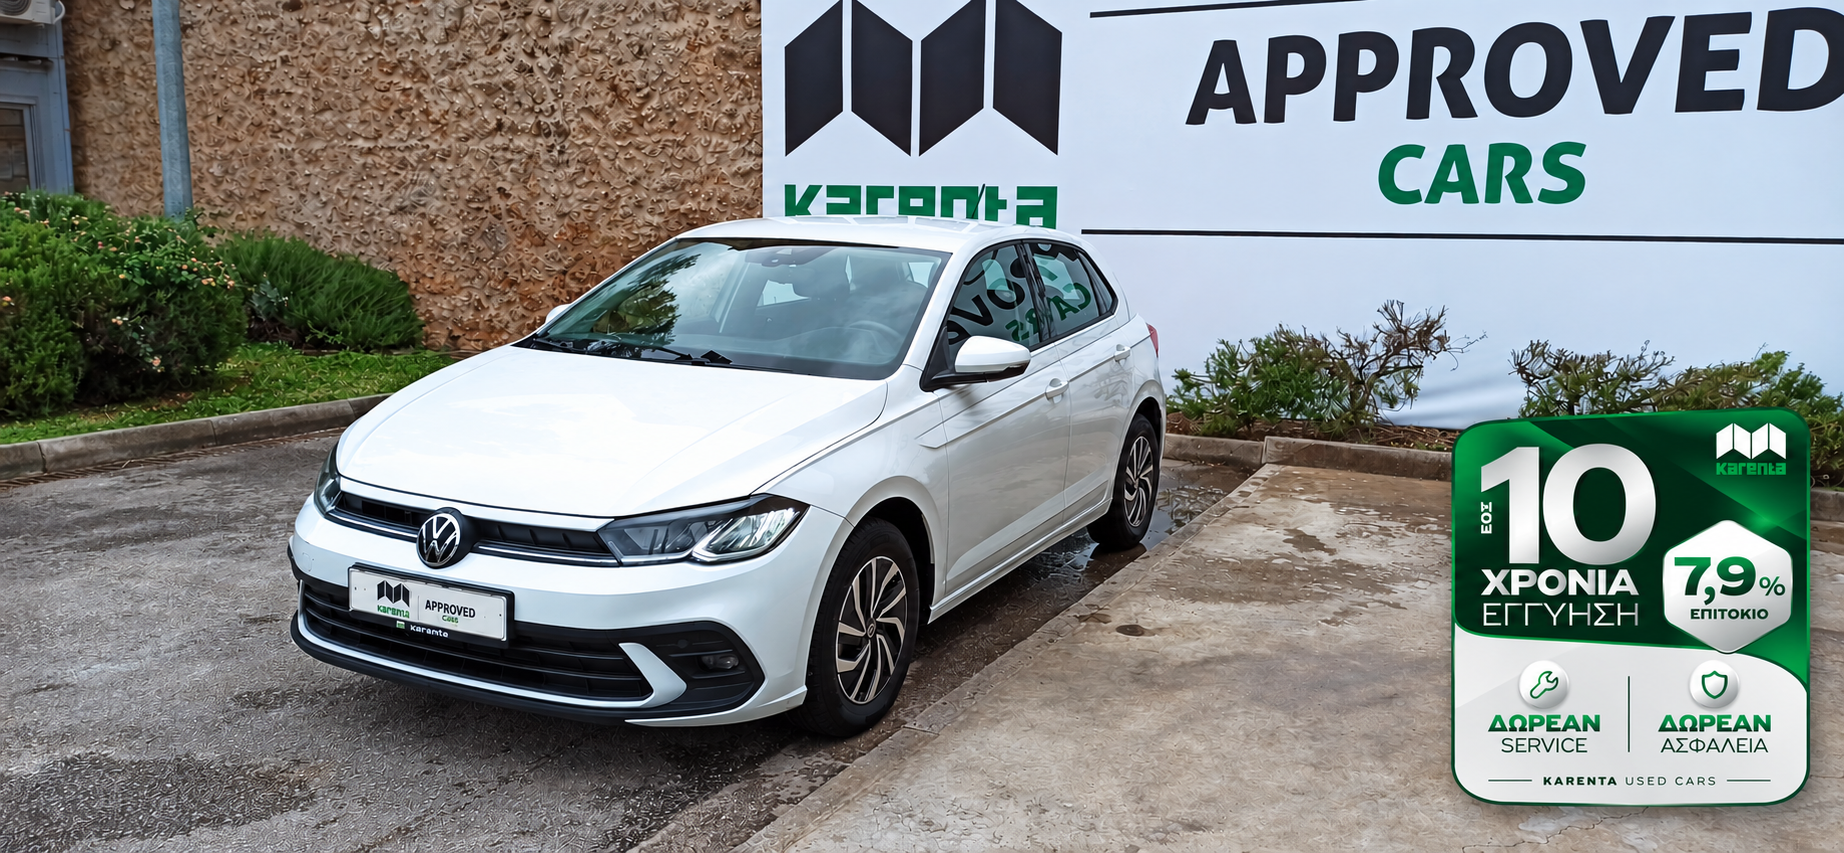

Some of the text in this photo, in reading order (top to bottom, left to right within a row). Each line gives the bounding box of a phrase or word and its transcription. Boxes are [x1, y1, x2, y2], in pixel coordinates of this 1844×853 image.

[1186, 6, 1844, 126] APPROVED
[1377, 141, 1587, 206] CARS
[424, 599, 476, 618] APPROVED
